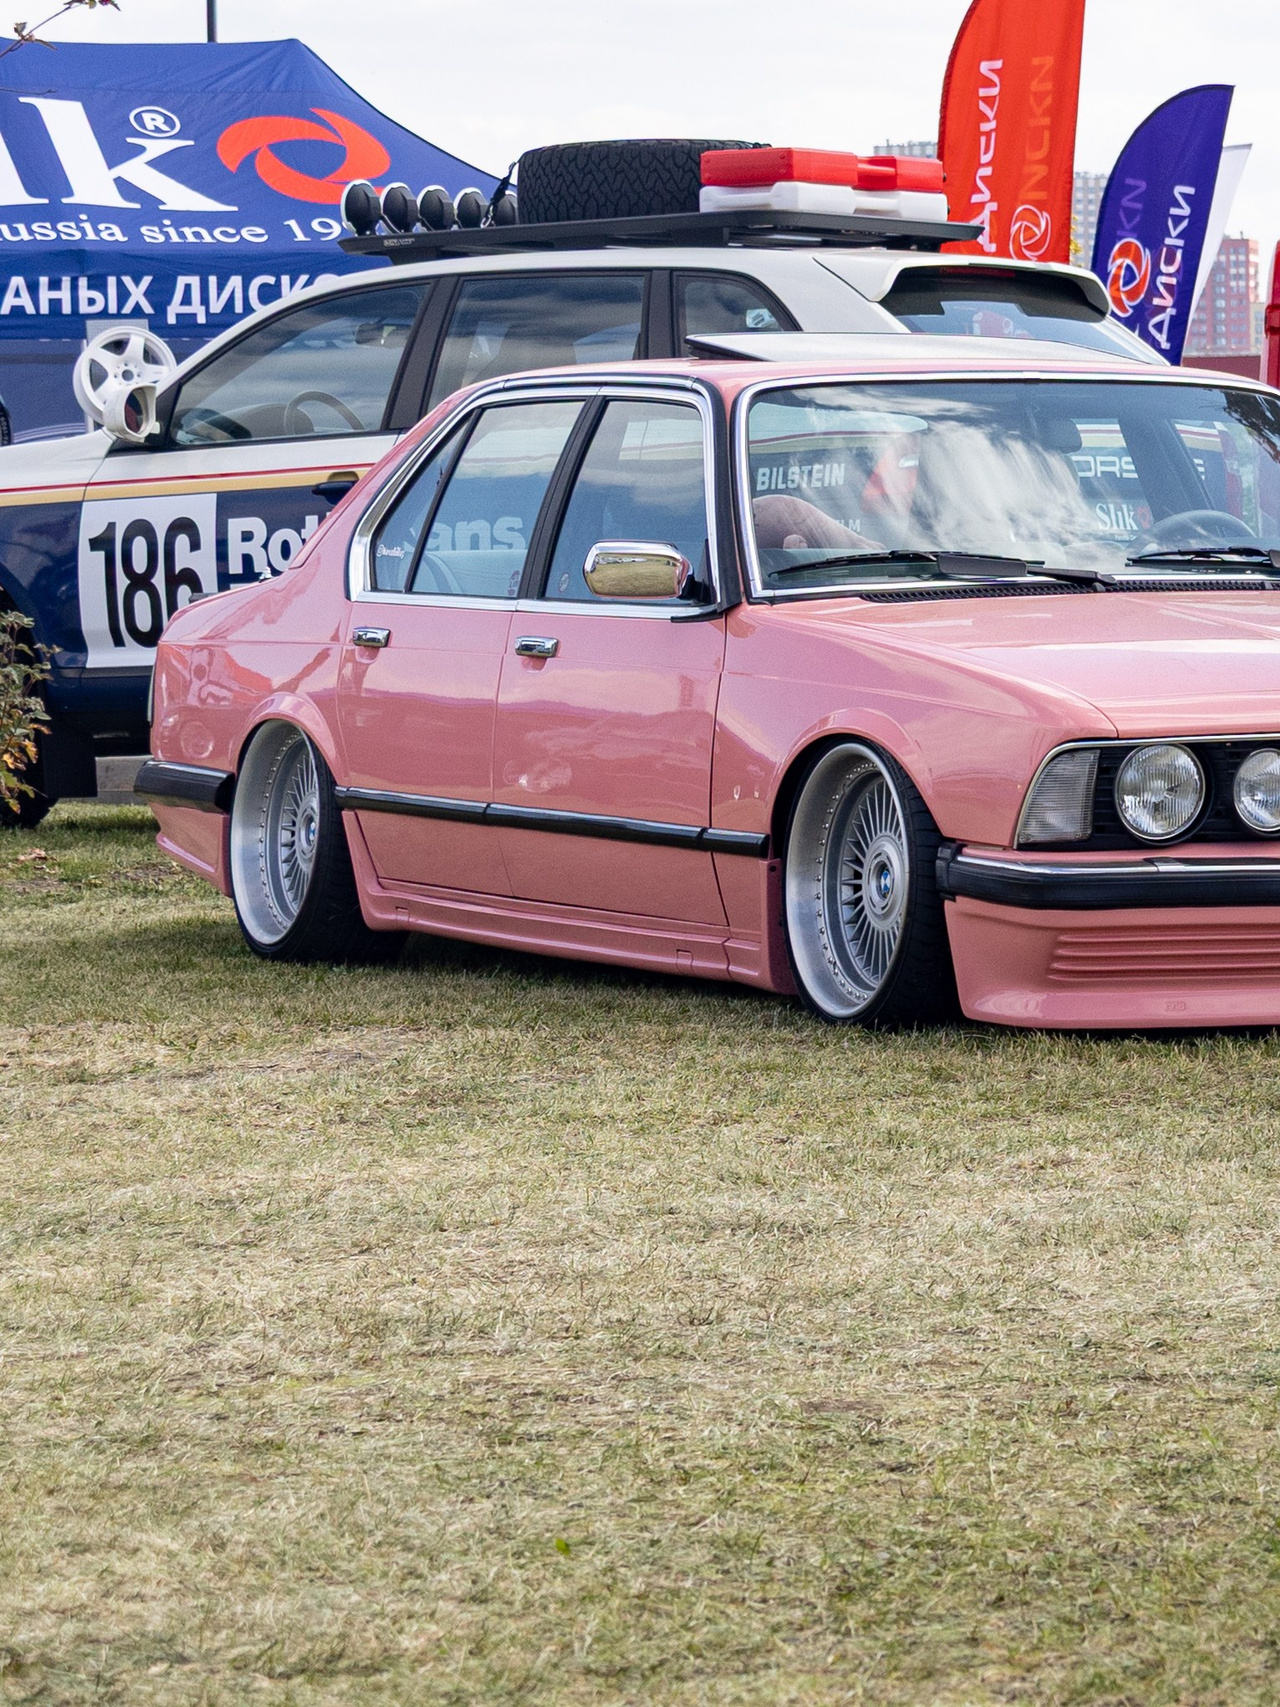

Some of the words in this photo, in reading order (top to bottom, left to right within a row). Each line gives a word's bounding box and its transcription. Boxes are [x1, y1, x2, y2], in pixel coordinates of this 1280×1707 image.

[0, 214, 129, 243] ussia
[139, 219, 268, 243] since
[283, 217, 348, 241] 19
[166, 273, 341, 325] ДИСК
[756, 463, 845, 491] BILSTEIN
[88, 517, 204, 648] 186
